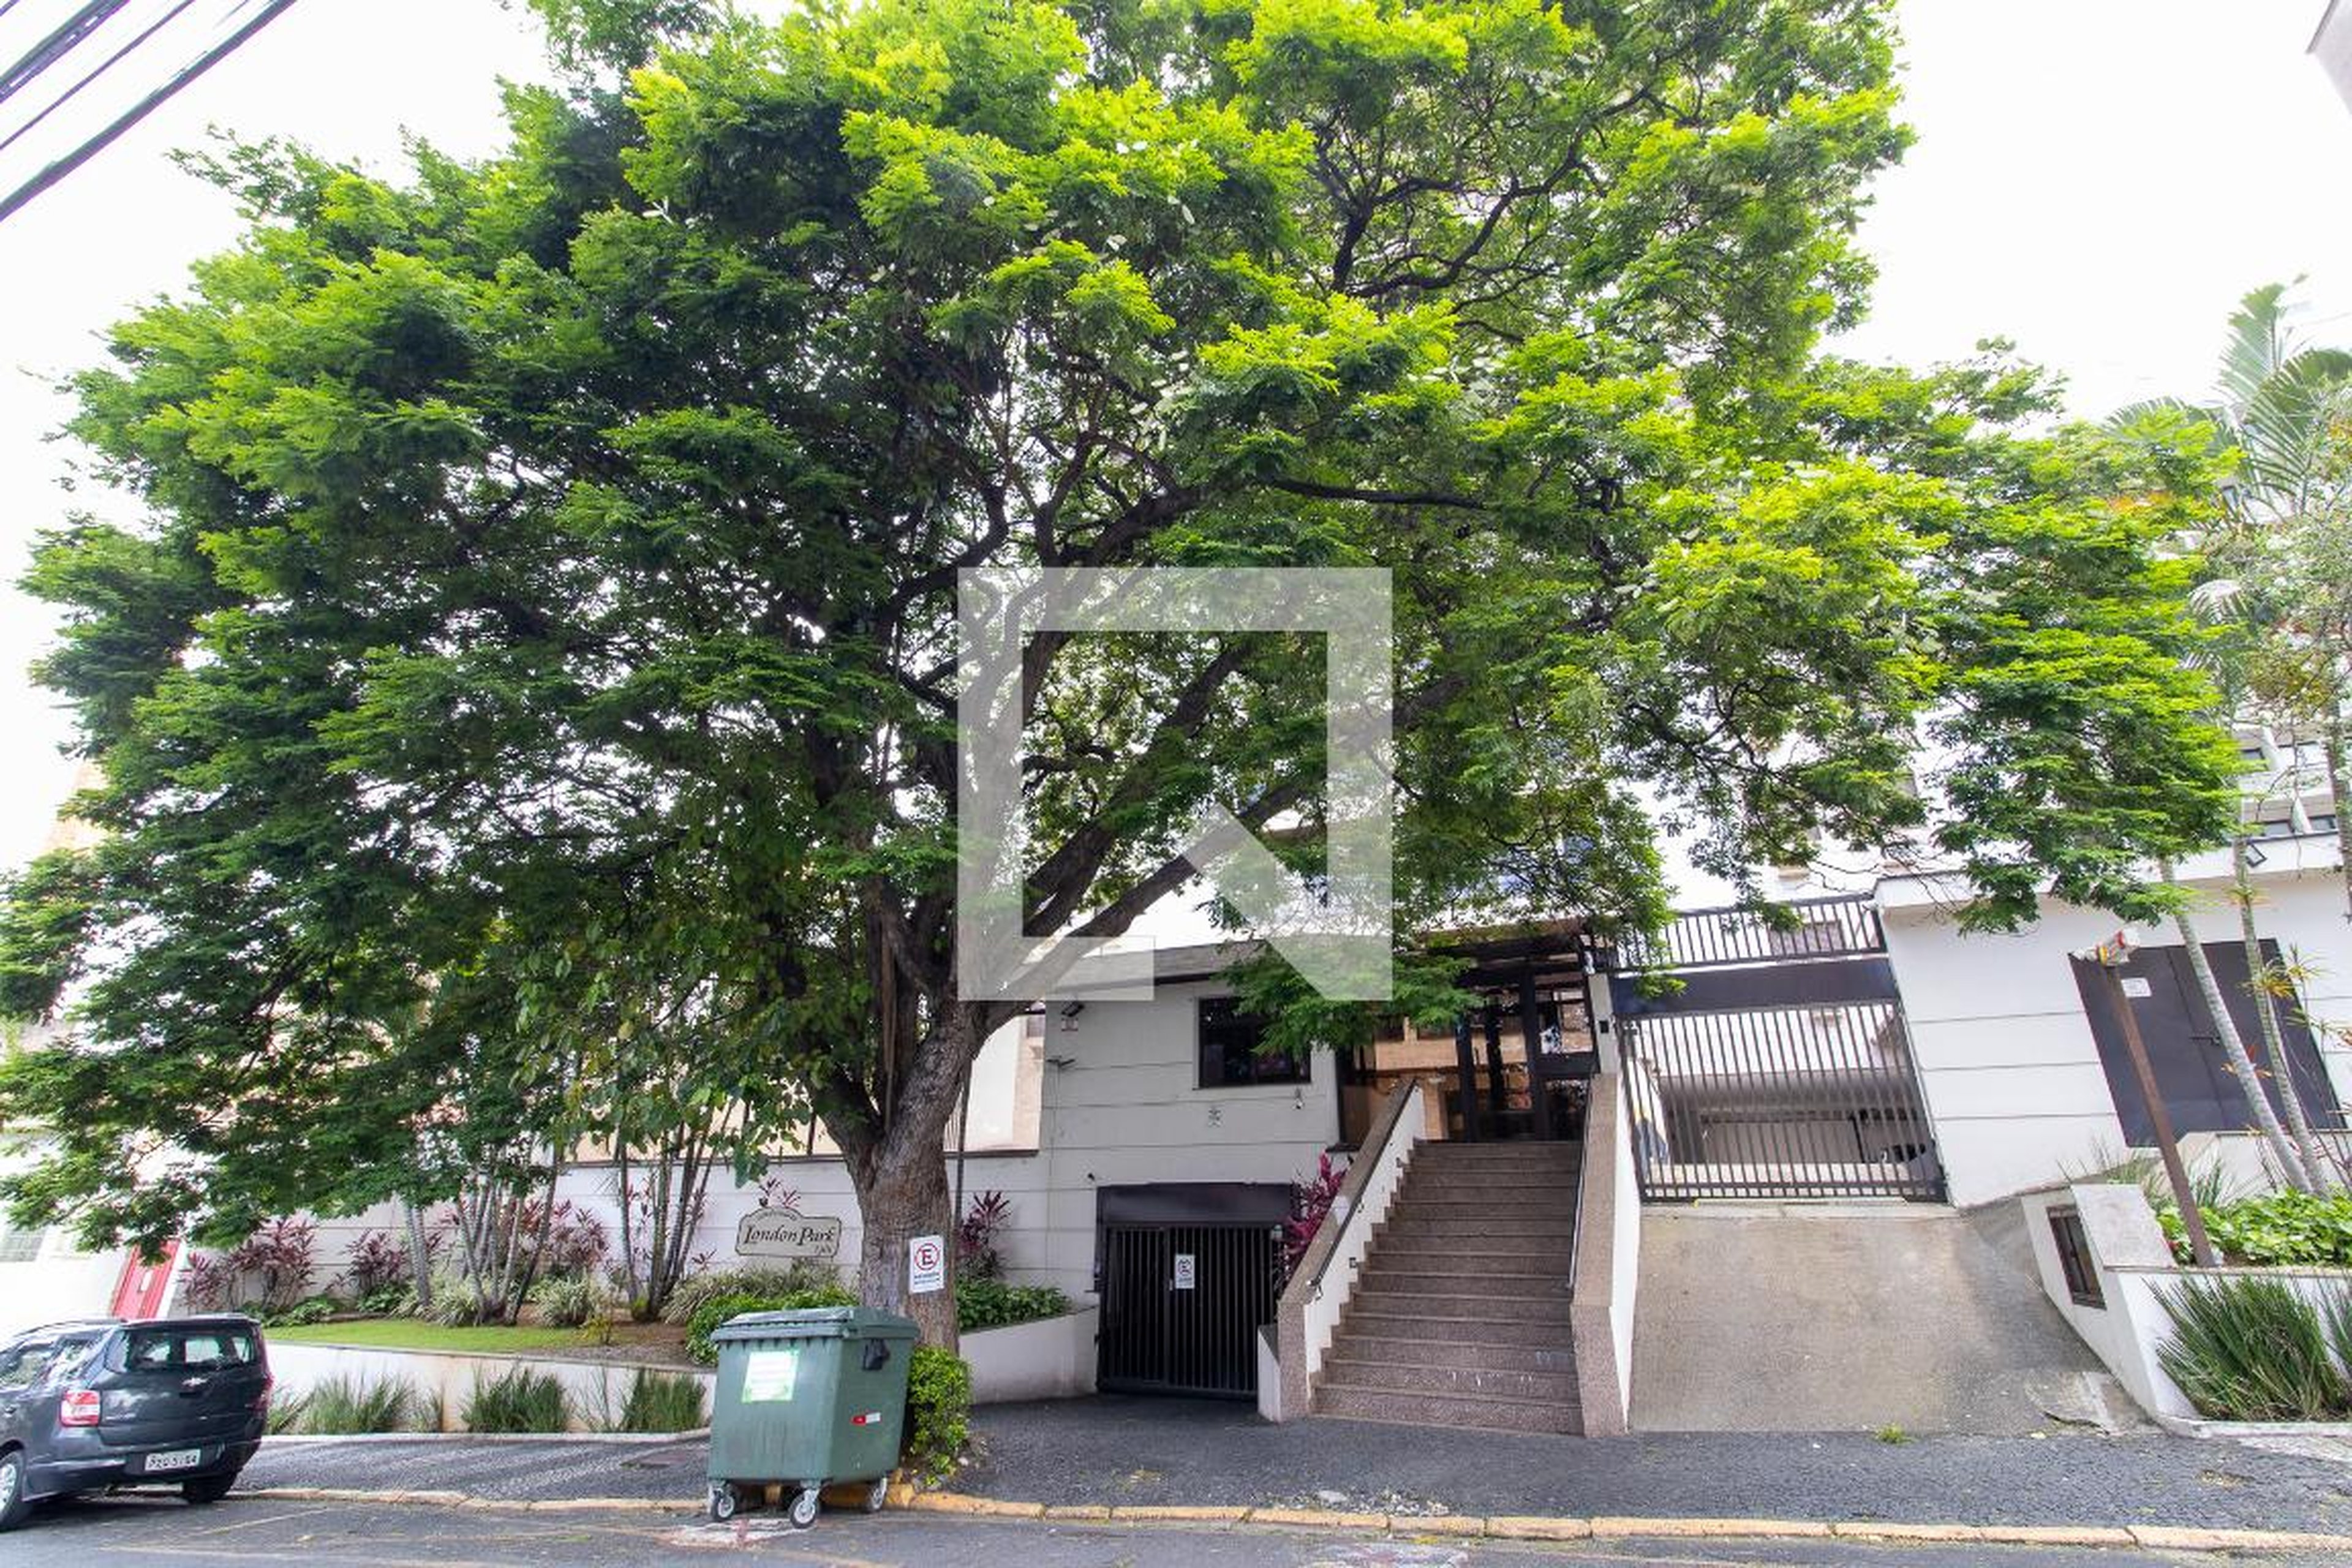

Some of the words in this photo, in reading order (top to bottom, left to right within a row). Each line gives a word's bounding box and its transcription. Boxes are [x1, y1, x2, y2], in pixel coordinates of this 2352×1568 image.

[744, 1224, 797, 1244] London
[797, 1226, 836, 1246] Park
[922, 1249, 933, 1266] E
